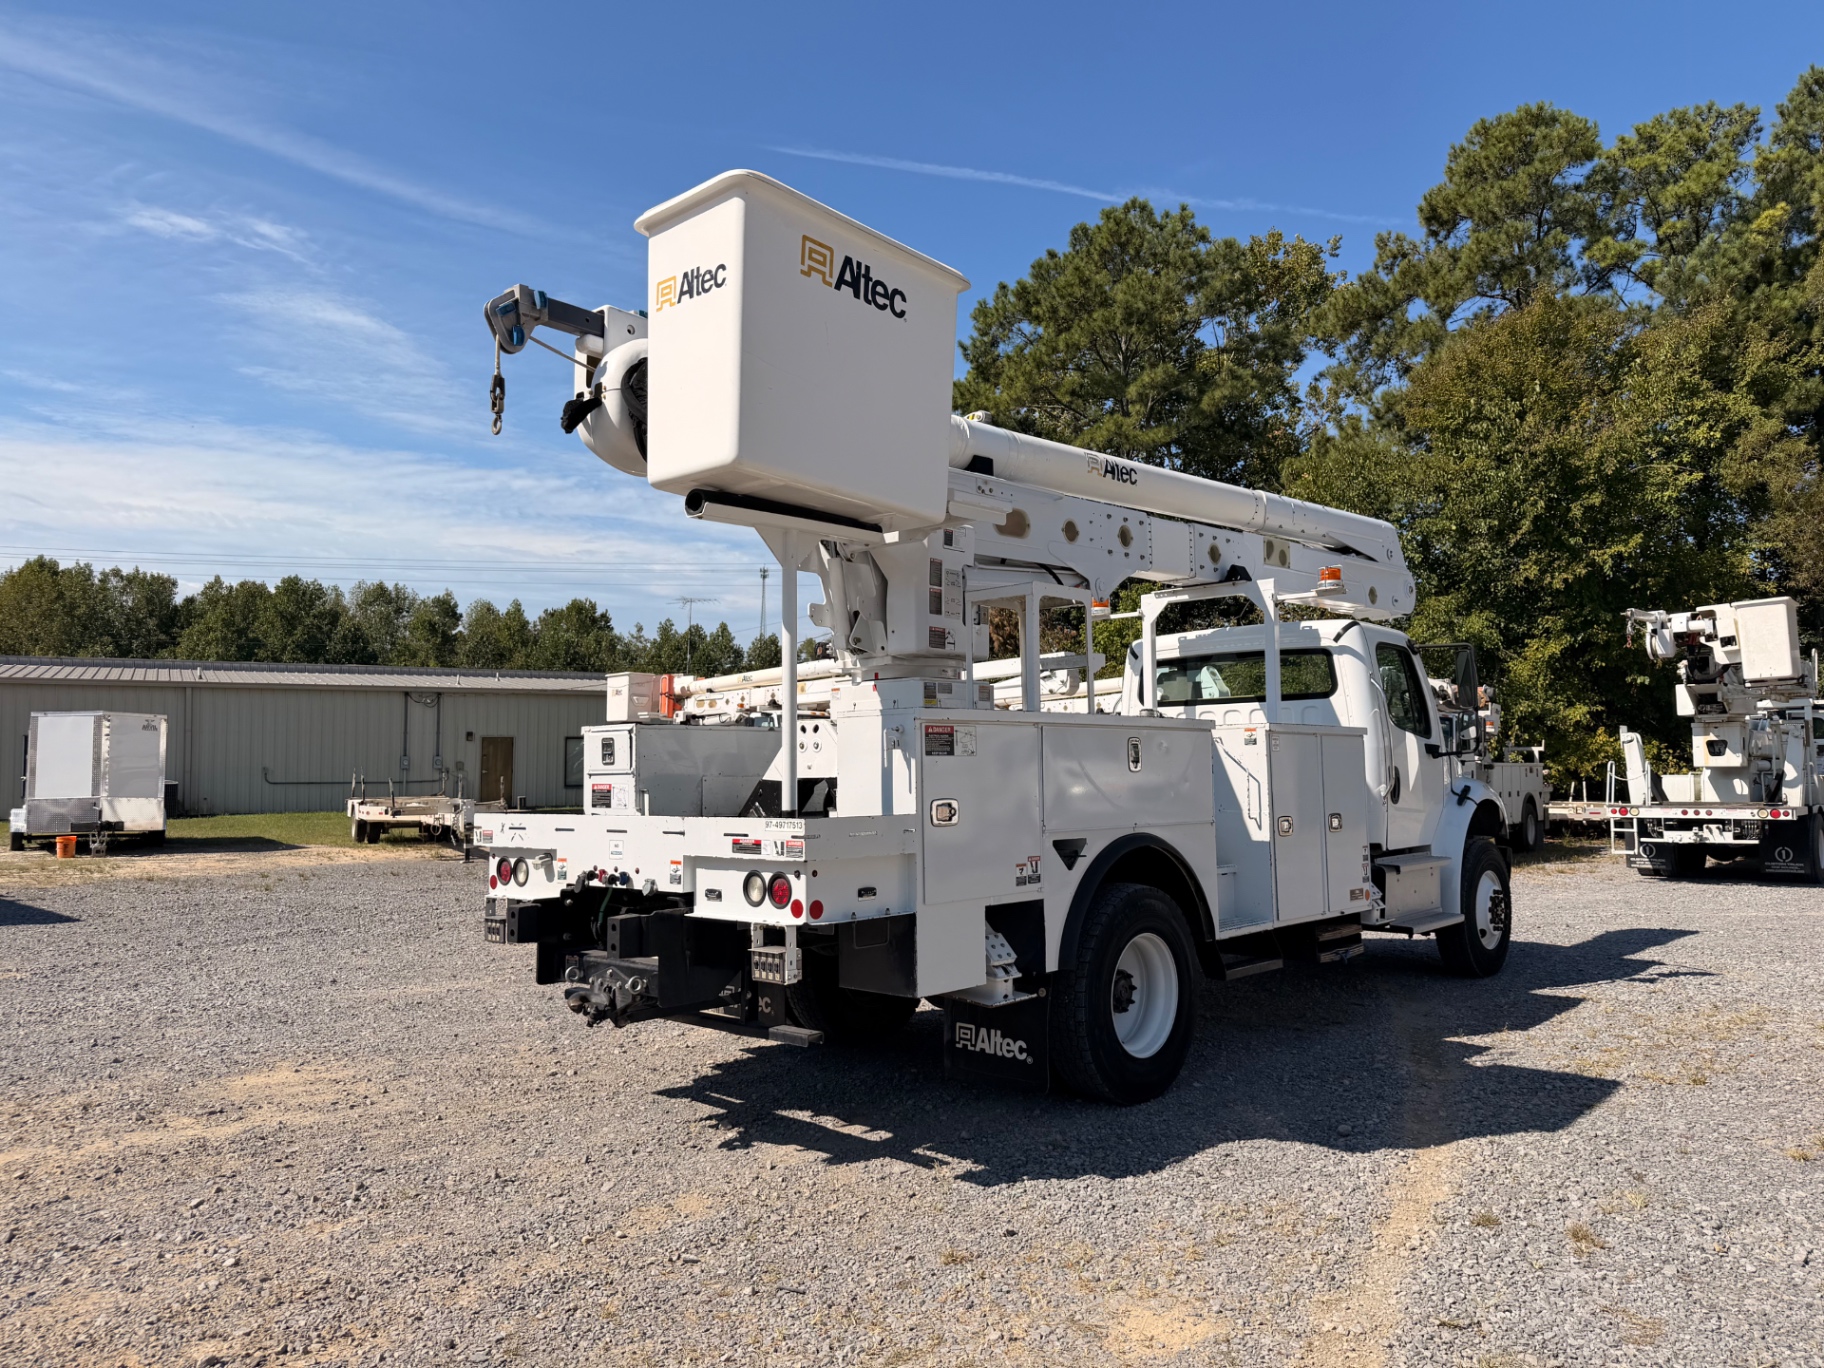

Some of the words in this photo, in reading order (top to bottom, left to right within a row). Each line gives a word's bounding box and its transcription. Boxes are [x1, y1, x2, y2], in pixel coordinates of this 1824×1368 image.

[677, 263, 727, 304] Altec
[834, 255, 907, 320] Altec
[1102, 458, 1138, 486] Altec
[765, 821, 803, 830] 97-49717513
[975, 1027, 1028, 1061] Altec
